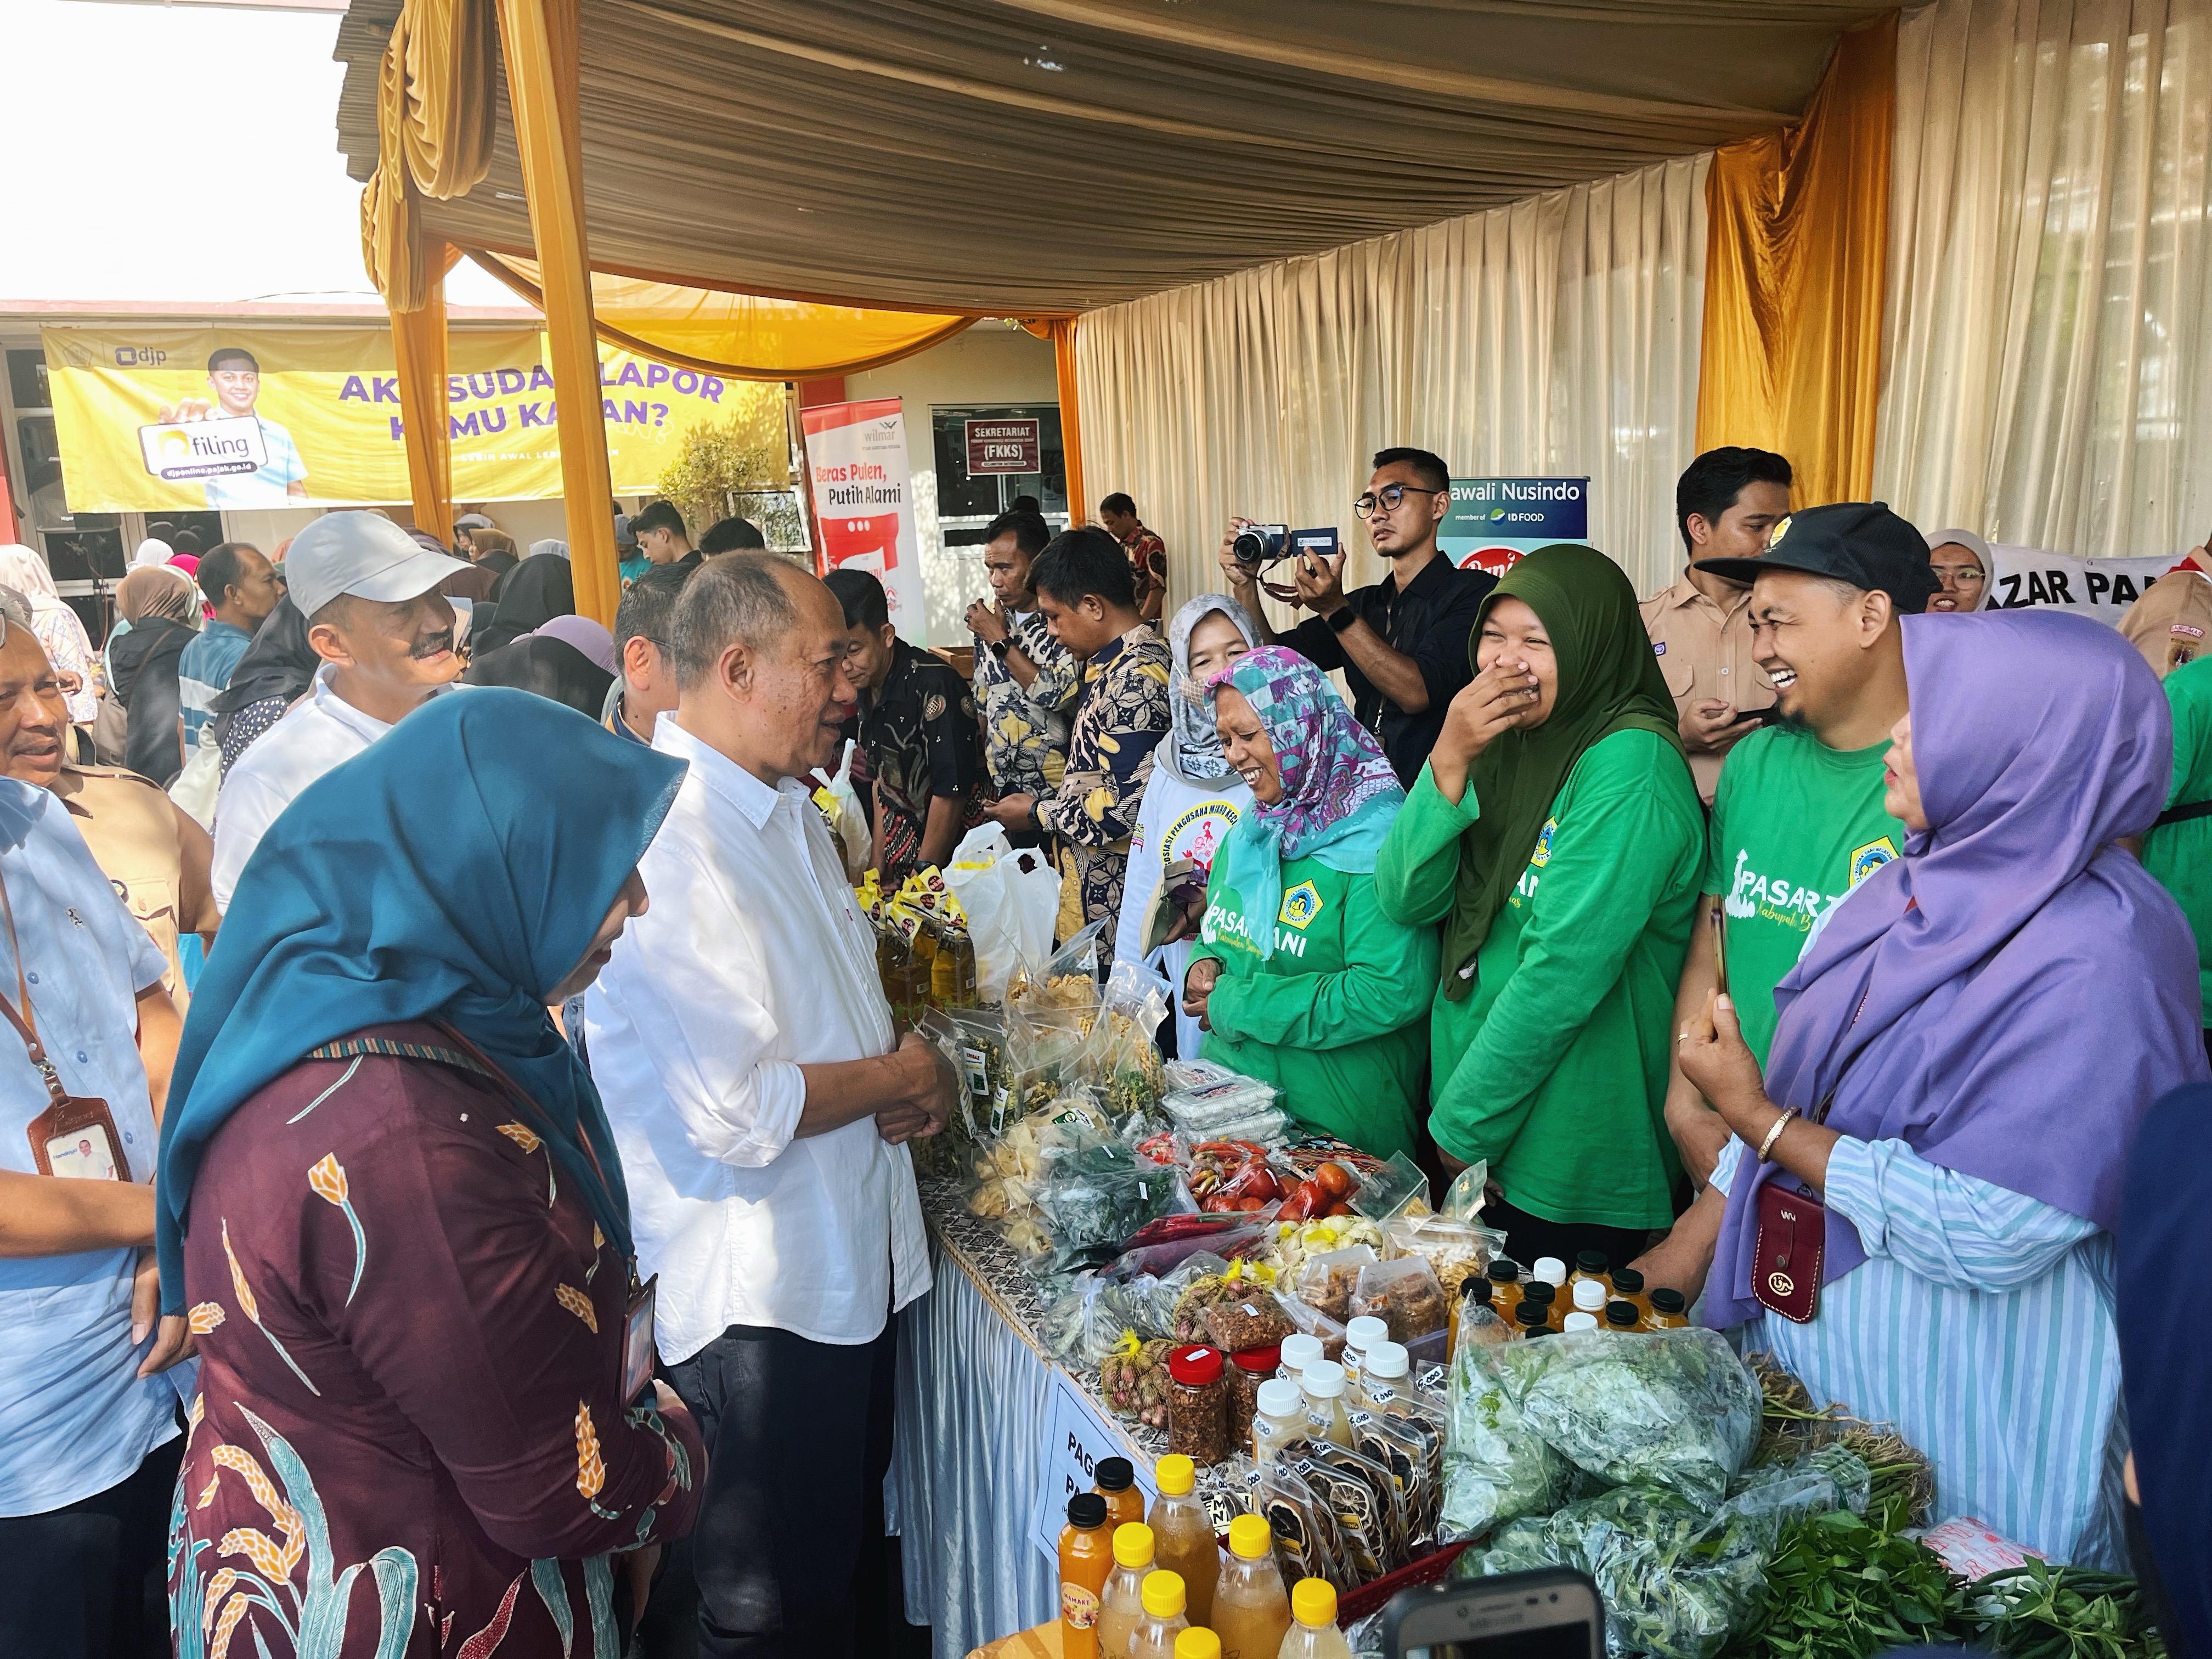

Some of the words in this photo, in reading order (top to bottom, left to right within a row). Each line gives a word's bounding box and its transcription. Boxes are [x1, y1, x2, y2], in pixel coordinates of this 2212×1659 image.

[139, 347, 167, 366] djp
[338, 376, 401, 403] AK
[448, 365, 554, 402] SUDA
[600, 363, 724, 403] LAPOR
[390, 407, 506, 441] KMU
[974, 427, 1030, 437] SEKRETARIAT
[864, 430, 895, 443] wilmar
[500, 450, 532, 460] AWAL
[984, 444, 1023, 461] (FKKS)
[816, 467, 847, 483] Beras
[850, 462, 887, 483] Pulen,
[828, 485, 864, 505] Putih
[865, 483, 901, 504] Alami
[1450, 482, 1496, 501] awali
[1502, 482, 1580, 501] Nusindo
[1519, 514, 1544, 522] FOOD
[1171, 806, 1208, 837] PENGUSAHA
[1739, 870, 1819, 918] PASAR
